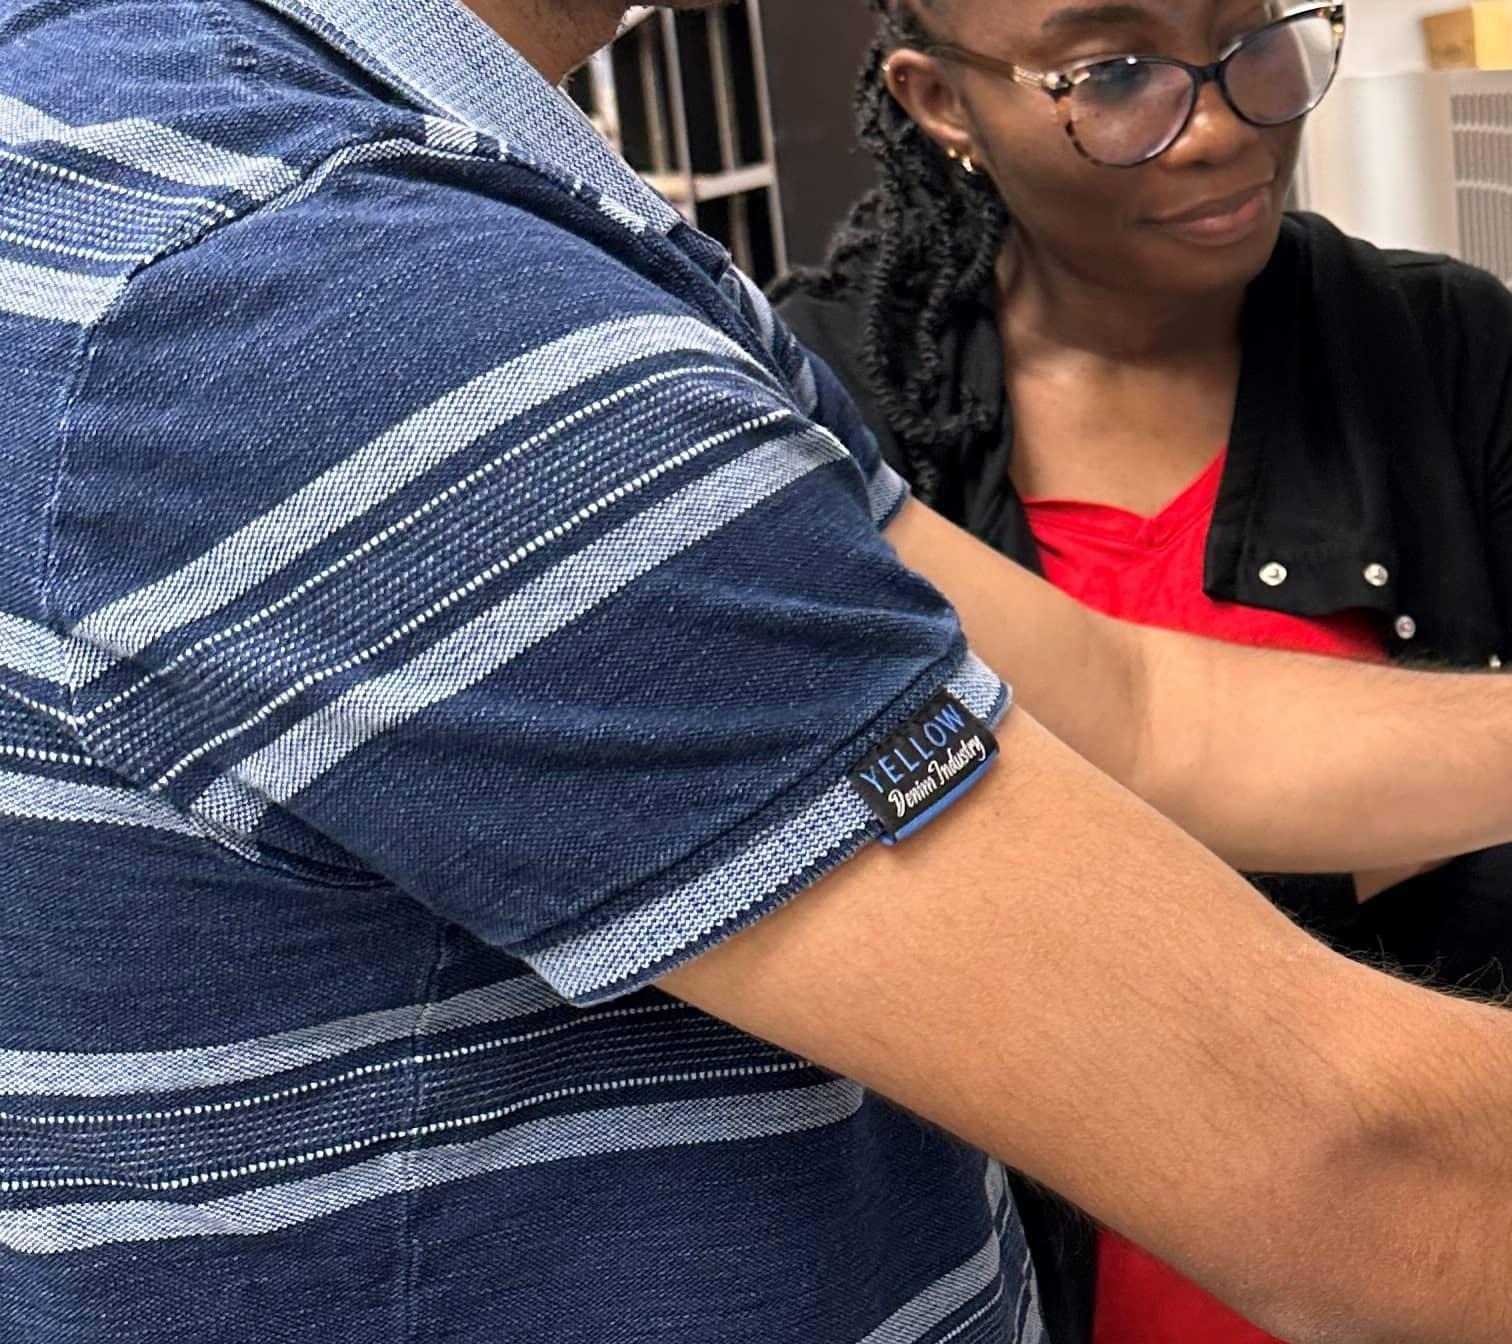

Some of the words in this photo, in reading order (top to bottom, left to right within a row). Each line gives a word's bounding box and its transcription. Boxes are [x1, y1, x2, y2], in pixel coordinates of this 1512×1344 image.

[859, 703, 966, 794] YELLOW
[887, 775, 937, 818] Denim
[927, 734, 986, 785] Industry
